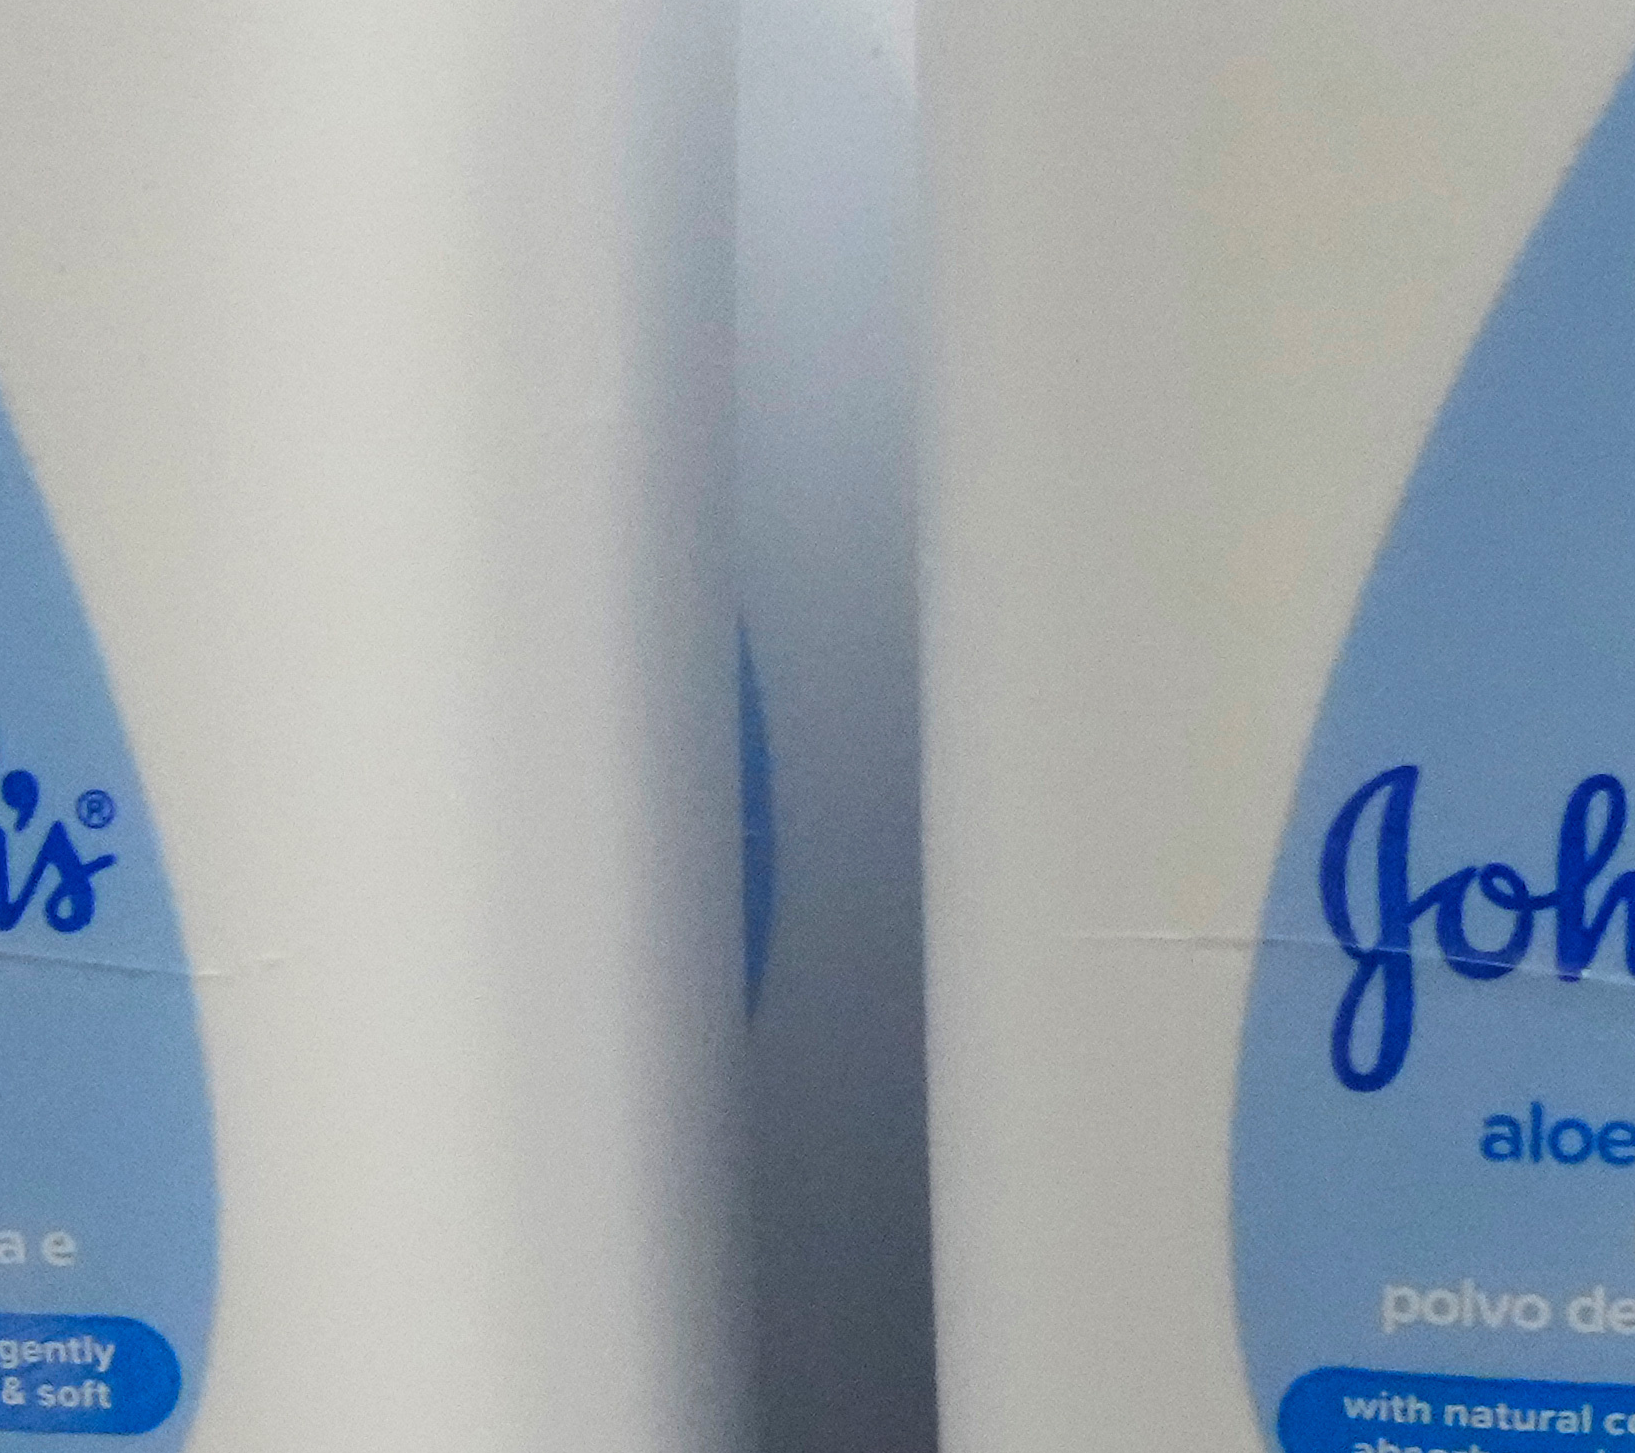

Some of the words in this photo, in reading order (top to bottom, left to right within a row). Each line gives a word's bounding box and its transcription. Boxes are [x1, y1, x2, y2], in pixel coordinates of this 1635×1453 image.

[1379, 1278, 1553, 1335] polvo
[35, 1377, 112, 1410] soft
[1342, 1390, 1433, 1426] with
[1443, 1396, 1594, 1434] natural
